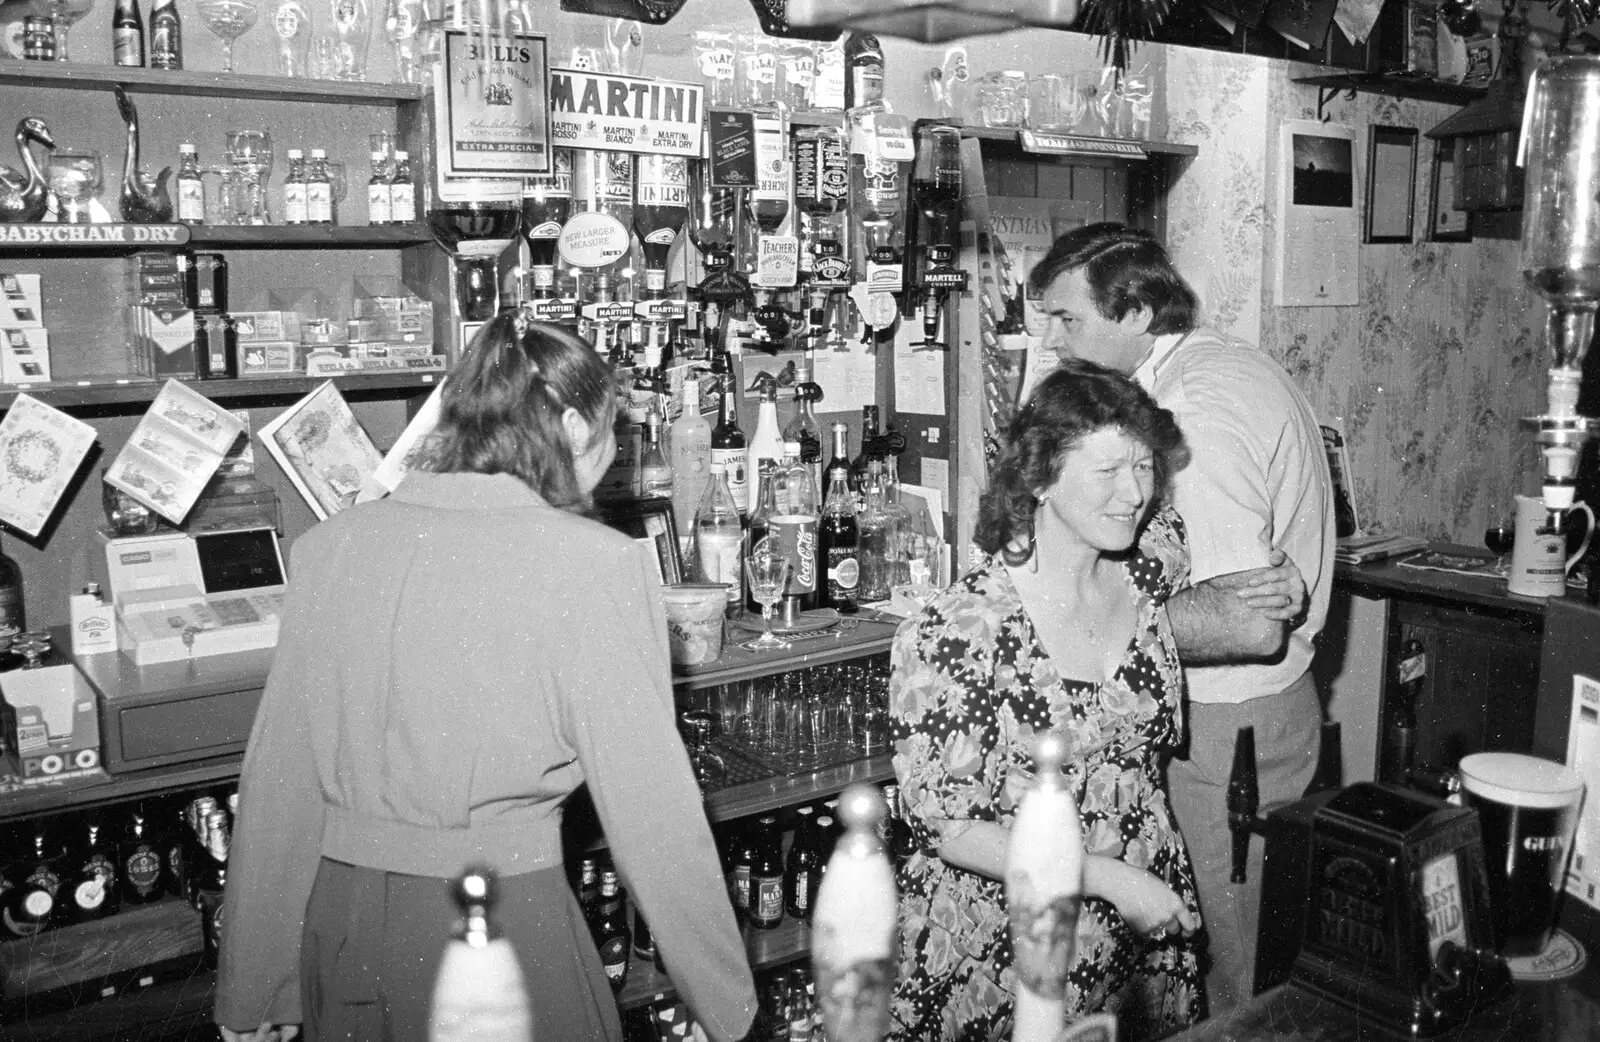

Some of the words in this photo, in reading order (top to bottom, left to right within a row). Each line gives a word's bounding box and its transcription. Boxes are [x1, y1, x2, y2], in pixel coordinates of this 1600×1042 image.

[551, 73, 697, 124] MARTINI
[552, 129, 578, 140] ROSSO
[603, 126, 636, 137] MARTINI
[657, 131, 689, 141] MARTINI
[605, 134, 634, 145] BIANCO
[652, 138, 675, 147] EXTRA
[676, 140, 693, 149] DRY
[498, 144, 537, 152] SPECIAL
[132, 226, 179, 242] DRY
[565, 233, 581, 243] NEW
[582, 227, 615, 238] LARGER
[569, 237, 610, 250] MEASURE
[924, 274, 963, 282] MARTELL
[539, 304, 572, 314] MARTINI
[599, 307, 631, 317] MARTINI
[651, 305, 683, 315] MARTINI
[24, 749, 99, 777] POLO
